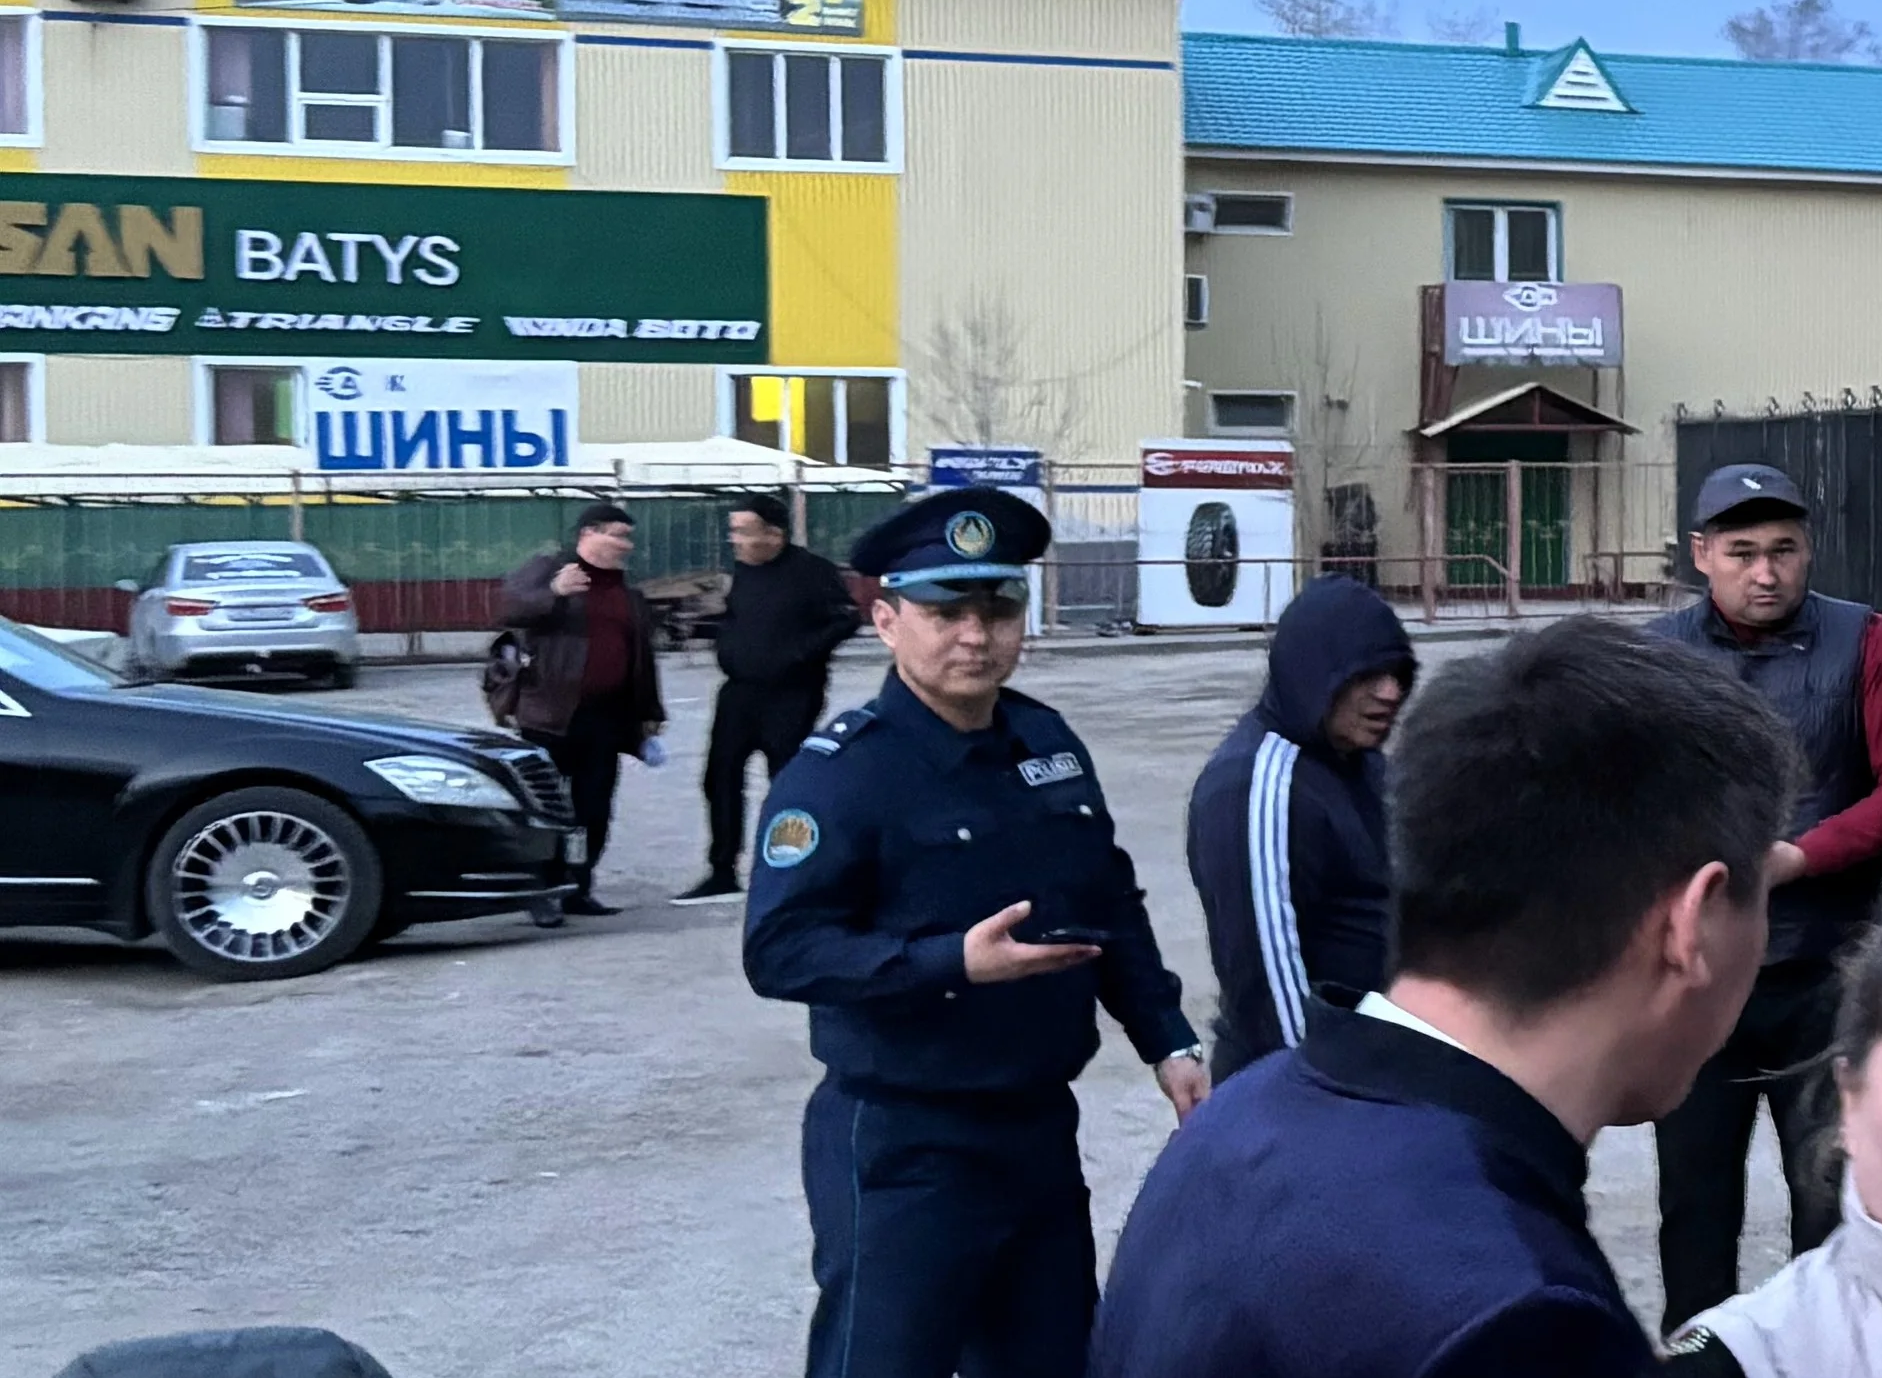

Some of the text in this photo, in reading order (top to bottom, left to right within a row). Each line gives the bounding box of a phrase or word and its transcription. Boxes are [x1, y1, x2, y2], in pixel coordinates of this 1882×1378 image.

[235, 229, 462, 287] BATYS
[1459, 315, 1604, 347] ШИНЫ
[316, 408, 569, 470] ШИНЫ
